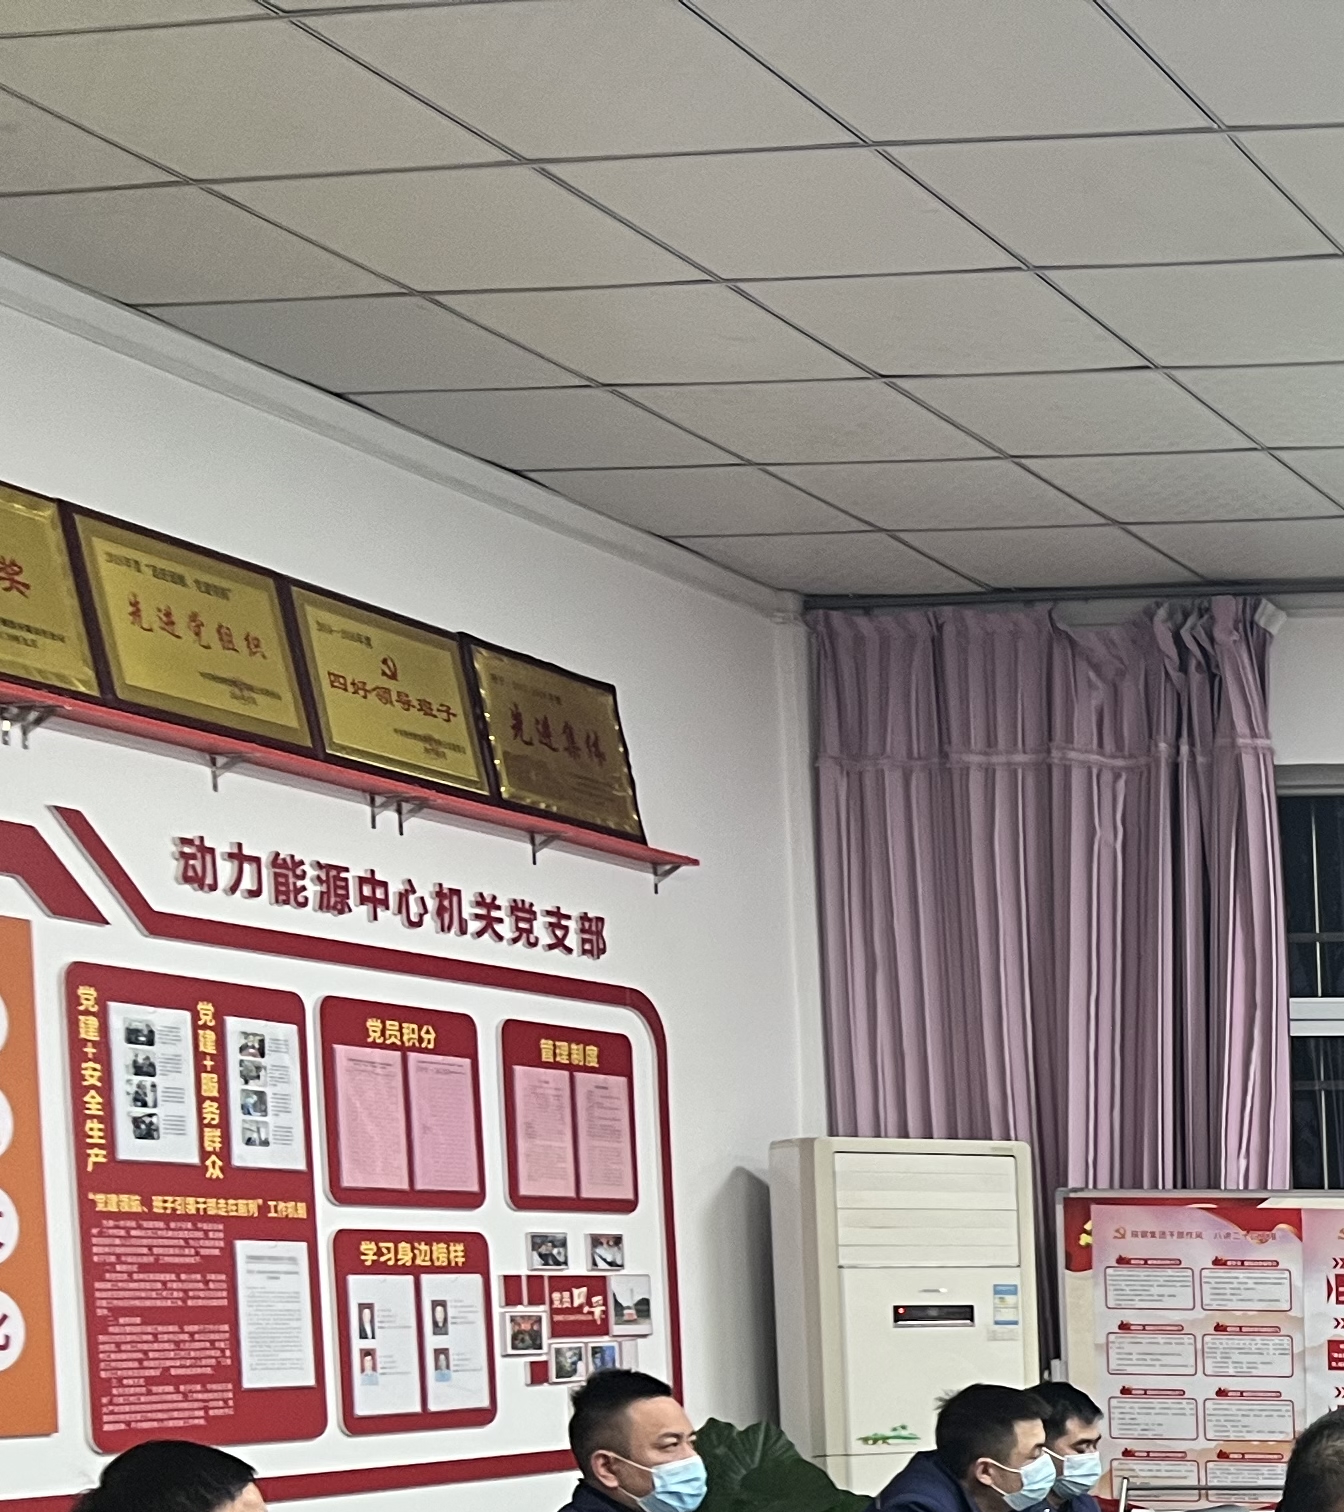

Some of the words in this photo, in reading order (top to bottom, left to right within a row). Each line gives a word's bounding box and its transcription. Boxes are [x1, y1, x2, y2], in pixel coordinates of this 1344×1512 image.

[128, 591, 268, 660] 先进党组织
[327, 670, 457, 723] 四好领导班子
[174, 835, 607, 960] 动力能源中心机关党支部
[366, 1018, 437, 1049] 党员积分
[540, 1039, 600, 1067] 管理制度
[77, 985, 107, 1172] 党建+安全生产
[360, 1241, 466, 1266] 学习身边榜样
